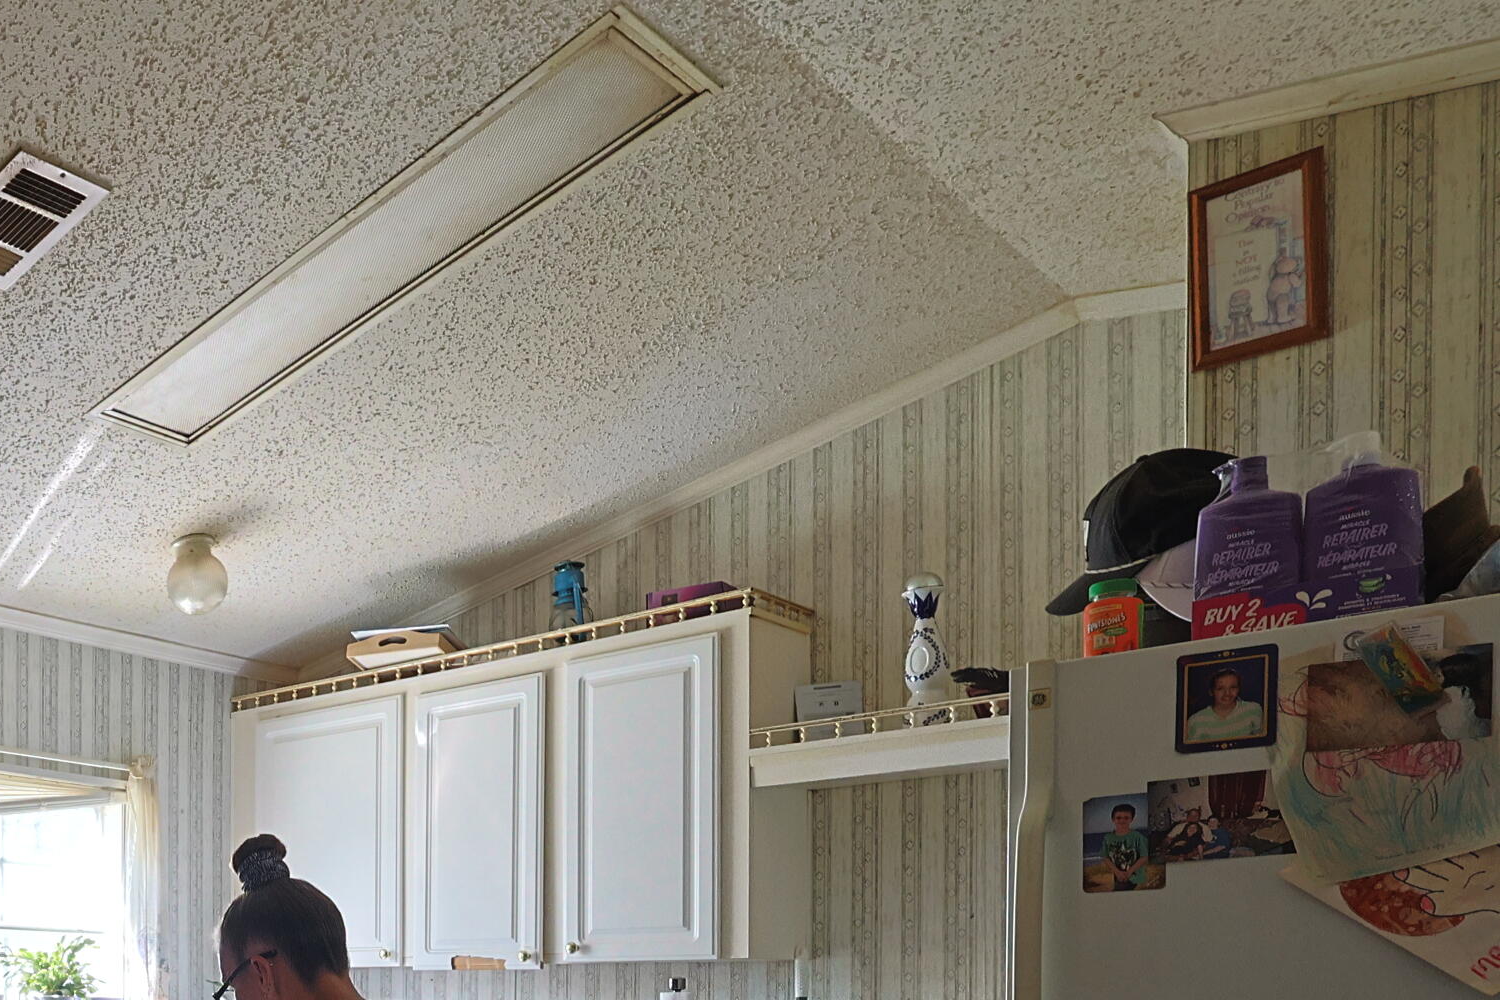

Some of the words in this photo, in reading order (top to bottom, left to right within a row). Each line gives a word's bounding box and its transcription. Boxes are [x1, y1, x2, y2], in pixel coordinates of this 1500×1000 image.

[1226, 528, 1256, 540] aussie
[1322, 522, 1389, 549] REPAIRER
[1211, 541, 1272, 567] REPAIRER
[1203, 602, 1245, 627] BUY
[1245, 598, 1261, 617] 2
[1221, 623, 1237, 637] &
[1240, 610, 1298, 633] SAVE
